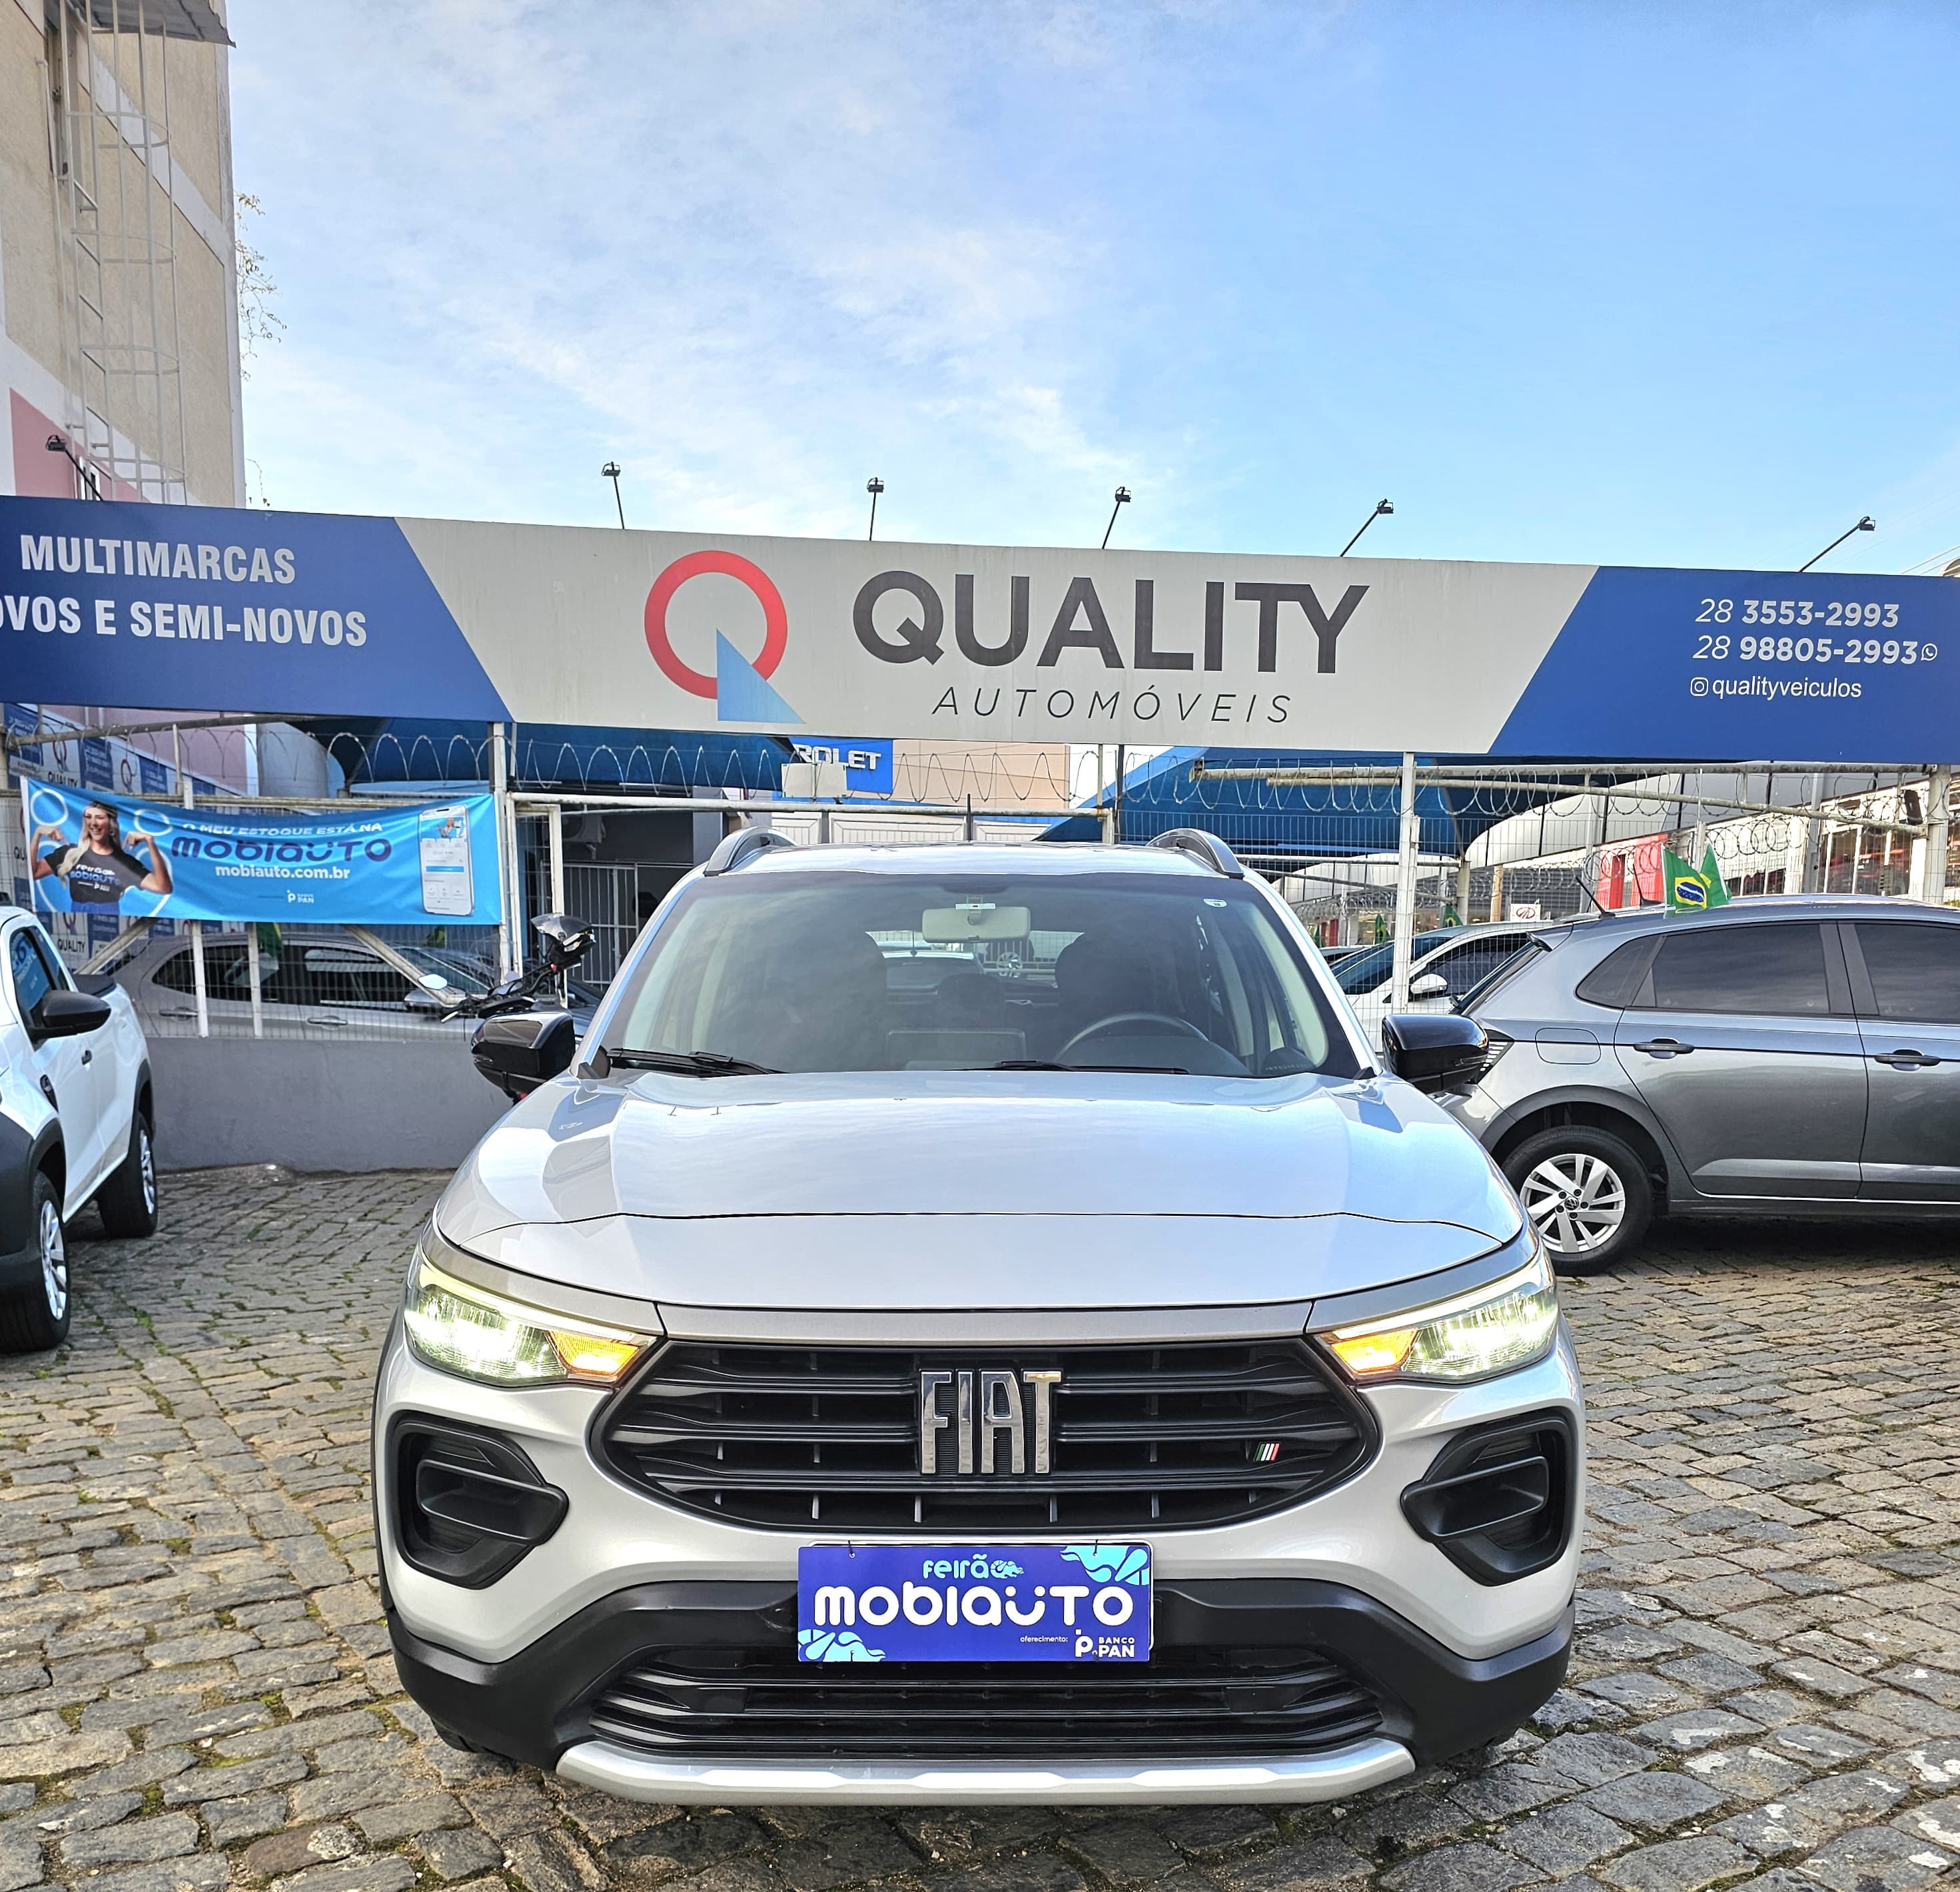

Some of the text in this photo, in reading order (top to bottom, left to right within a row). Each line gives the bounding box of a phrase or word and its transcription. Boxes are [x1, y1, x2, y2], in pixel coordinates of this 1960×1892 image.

[21, 535, 296, 584] MULTIMARCAS
[0, 595, 366, 646] VOS E SEMI-NOVOS
[853, 571, 1369, 674] QUALITY
[1695, 598, 1899, 628] 28 3553-2993
[1692, 635, 1918, 664] 28 98805-2993
[1712, 676, 1861, 701] qualityveiculos
[933, 684, 1292, 724] AUTOMÓVEIS
[200, 825, 235, 834] MEU
[239, 827, 312, 836] ESTOQUE
[359, 823, 382, 832] NA
[215, 865, 350, 879] mobiauto.com.br
[57, 938, 86, 953] QUALITY
[919, 1370, 1062, 1474] FIAT
[1098, 1645, 1135, 1658] PAN
